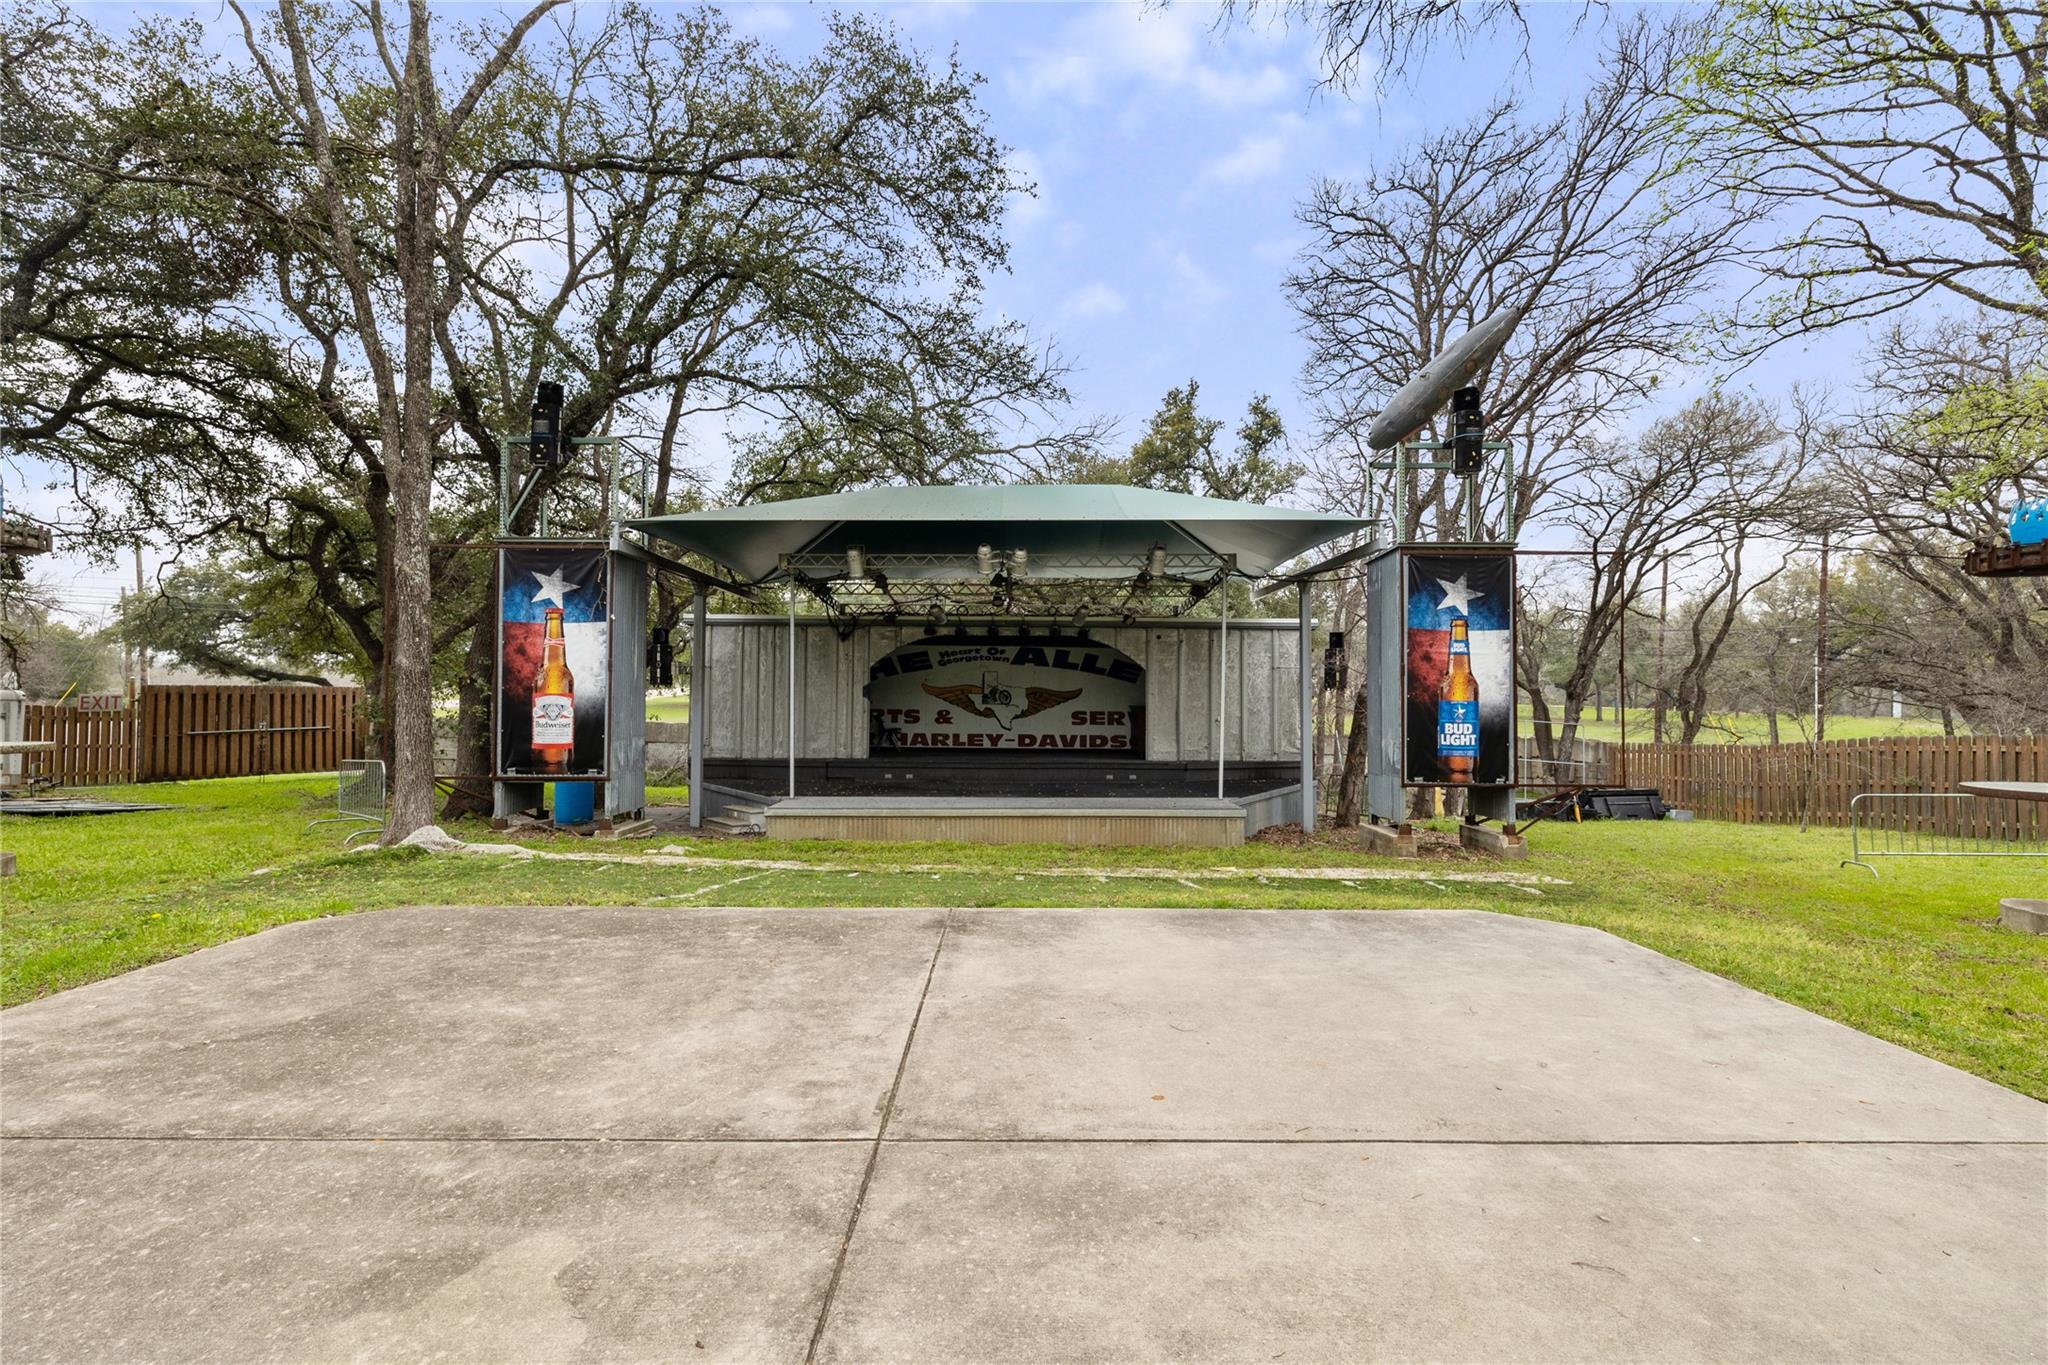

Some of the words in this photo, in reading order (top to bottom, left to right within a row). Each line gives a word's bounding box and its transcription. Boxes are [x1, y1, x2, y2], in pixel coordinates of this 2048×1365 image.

[938, 648, 981, 658] Heart
[938, 655, 1010, 666] Georgetown
[80, 695, 121, 710] EXIT
[935, 709, 953, 724] &
[1071, 711, 1132, 726] SER
[535, 720, 571, 729] Budweiser
[1444, 723, 1473, 734] BUD
[894, 733, 1134, 748] HARLEY-DAVIDS
[1441, 734, 1477, 746] LIGHT
